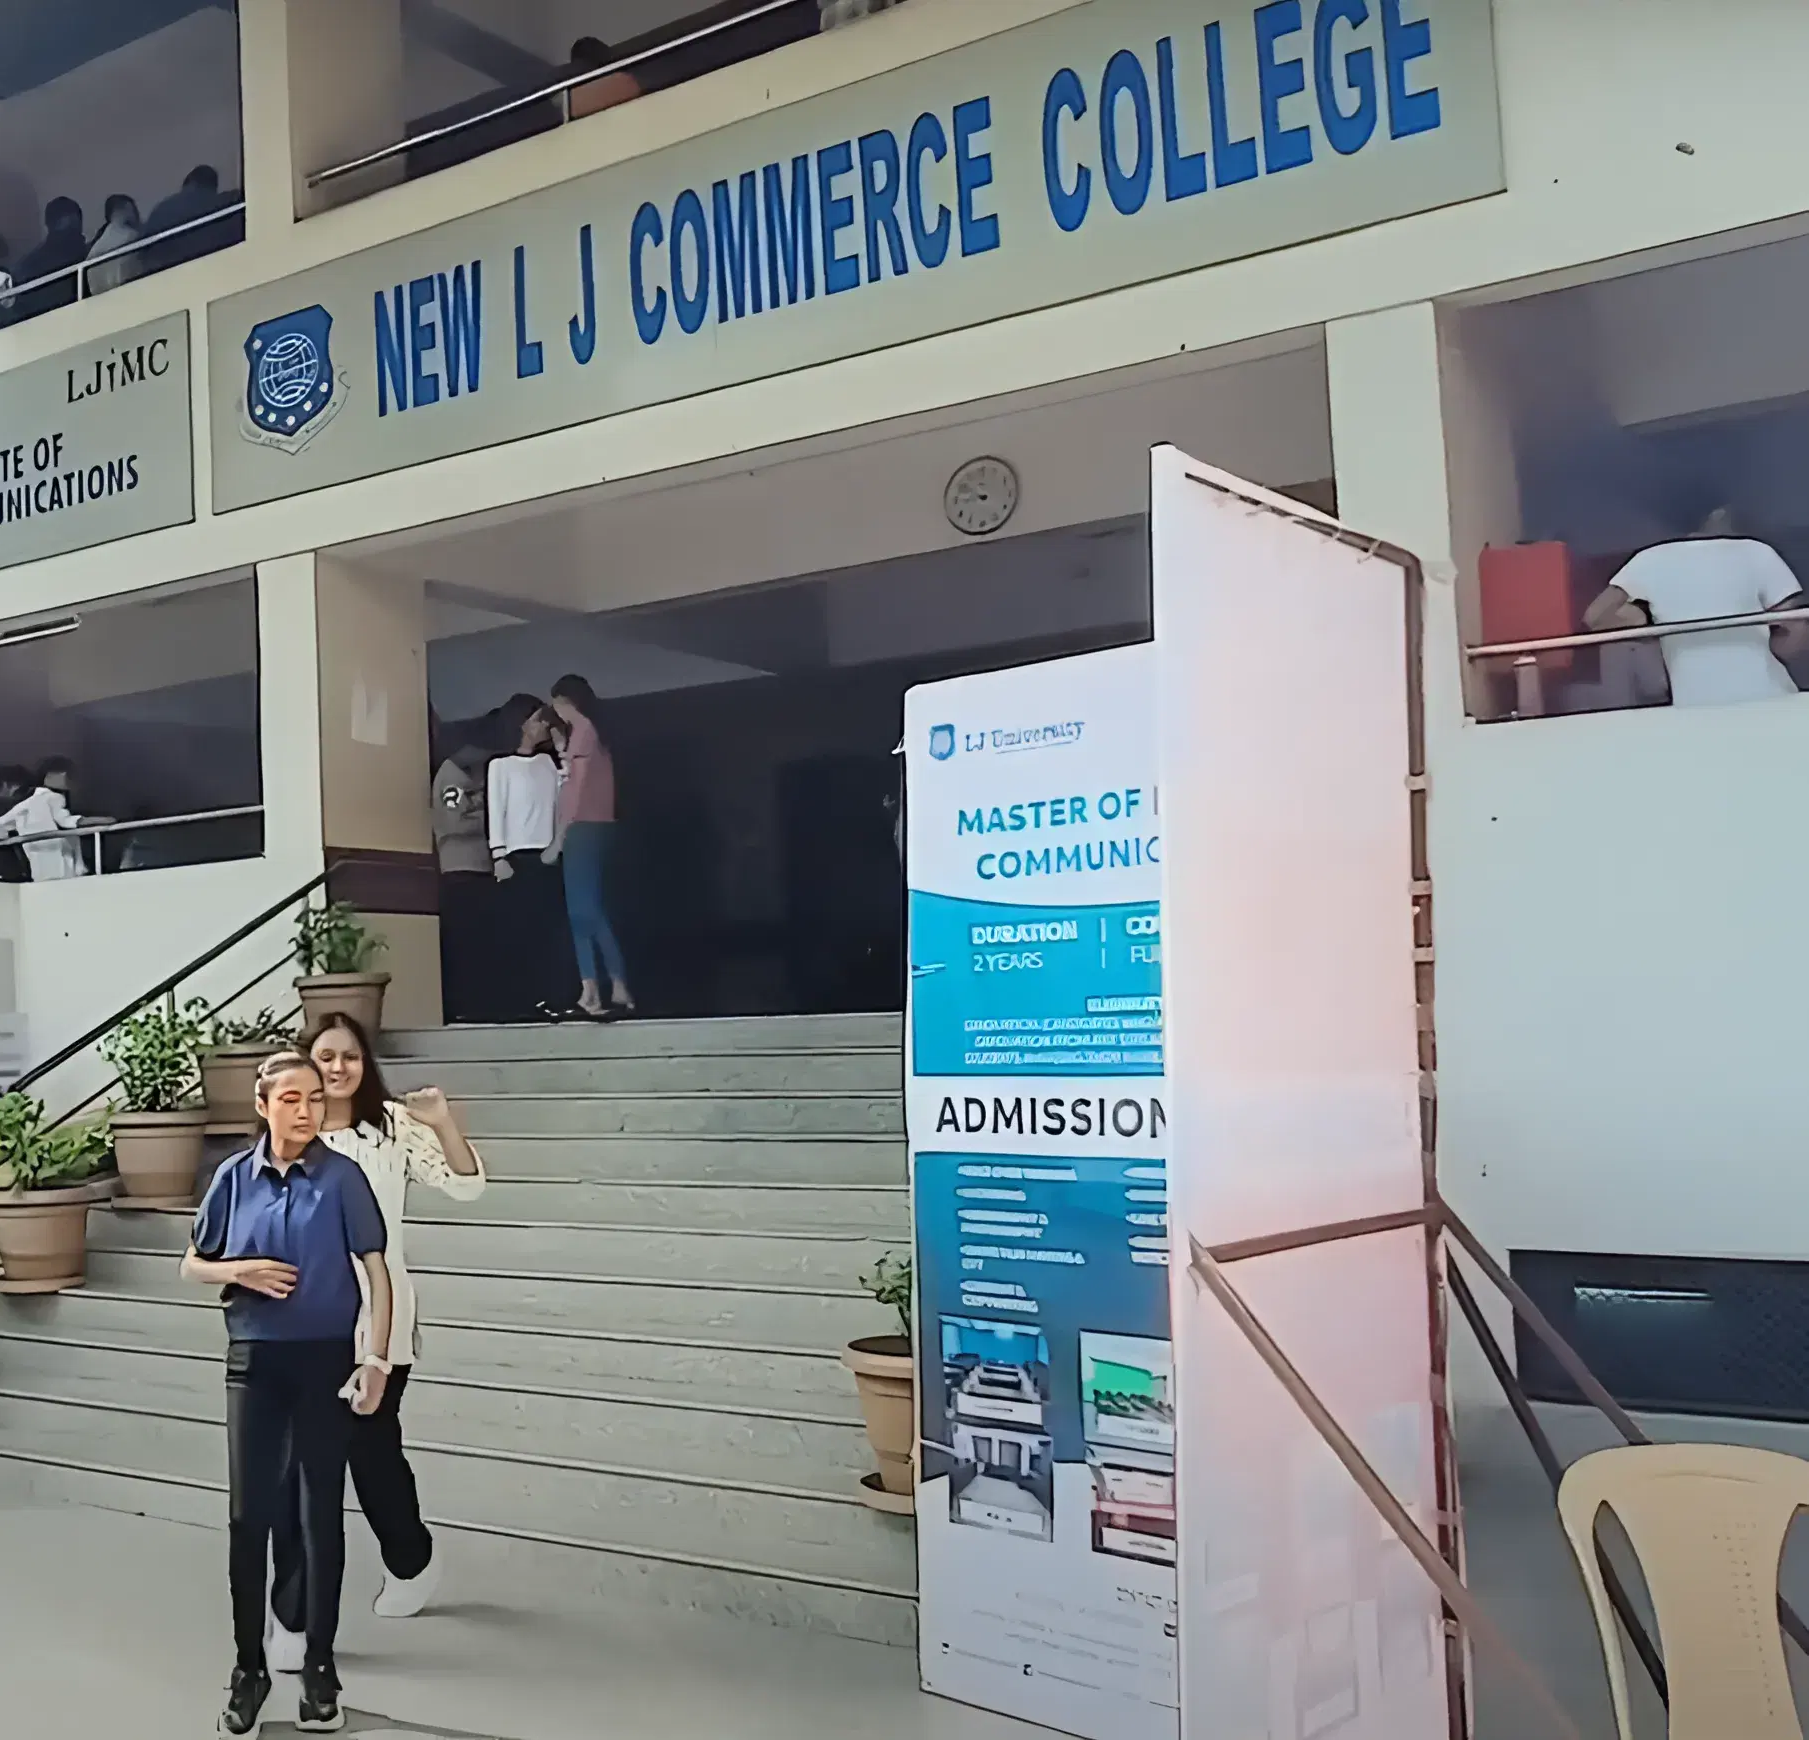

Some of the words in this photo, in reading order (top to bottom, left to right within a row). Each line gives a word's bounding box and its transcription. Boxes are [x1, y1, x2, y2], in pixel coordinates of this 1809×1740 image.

[374, 260, 481, 417] NEW
[514, 245, 543, 379] L
[568, 224, 596, 365] J
[630, 95, 1000, 345] COMMERCE
[1042, 0, 1441, 232] COLLEGE
[33, 432, 65, 473] OF
[957, 796, 1088, 837] MASTER
[1098, 788, 1141, 820] OF
[976, 836, 1160, 880] COMMUNIC
[972, 920, 1078, 944] DURATION
